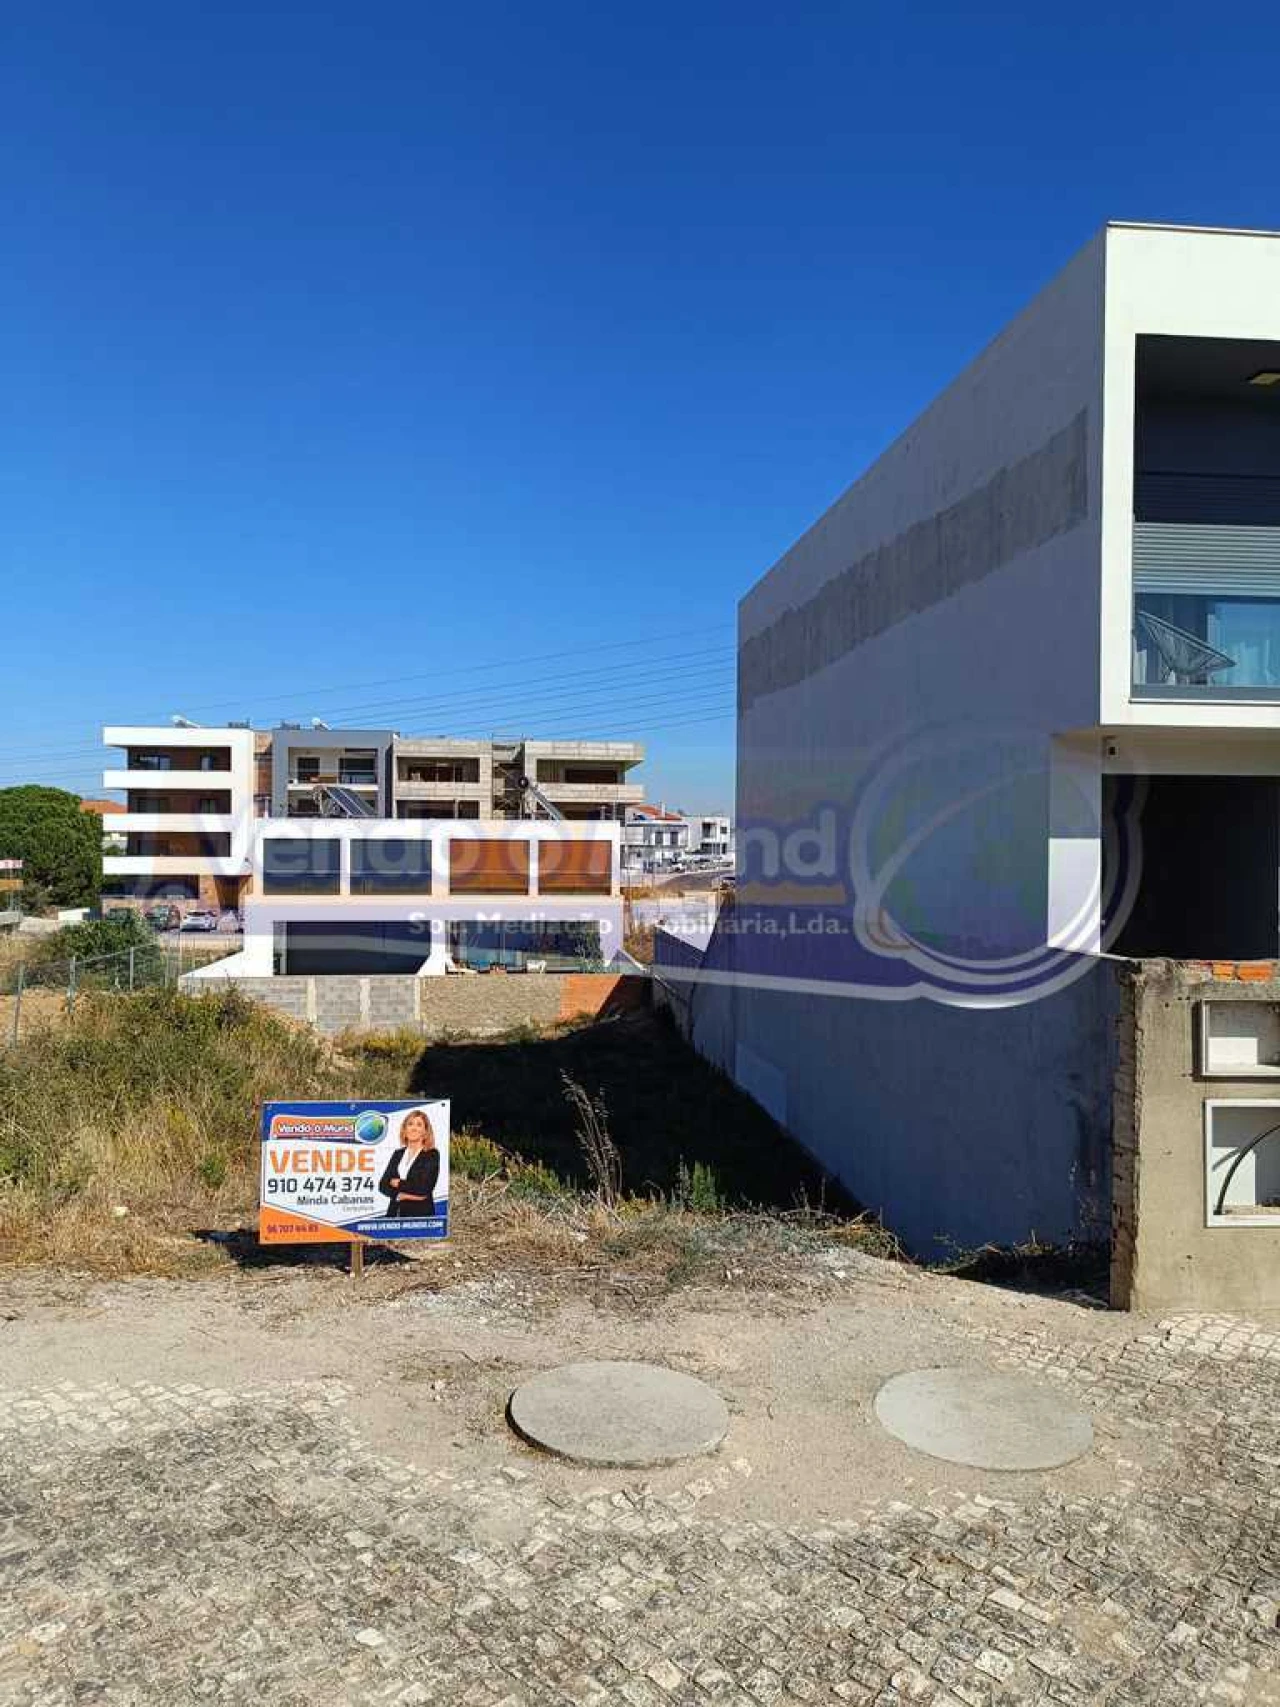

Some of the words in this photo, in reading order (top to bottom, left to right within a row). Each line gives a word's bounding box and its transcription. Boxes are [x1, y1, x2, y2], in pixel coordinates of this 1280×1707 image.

[279, 1123, 311, 1133] Vendo
[269, 1149, 376, 1174] VENDE
[267, 1178, 298, 1194] 910
[303, 1177, 336, 1192] 474
[341, 1176, 374, 1192] 374
[296, 1194, 329, 1206] Minda
[331, 1194, 374, 1205] Cabanas
